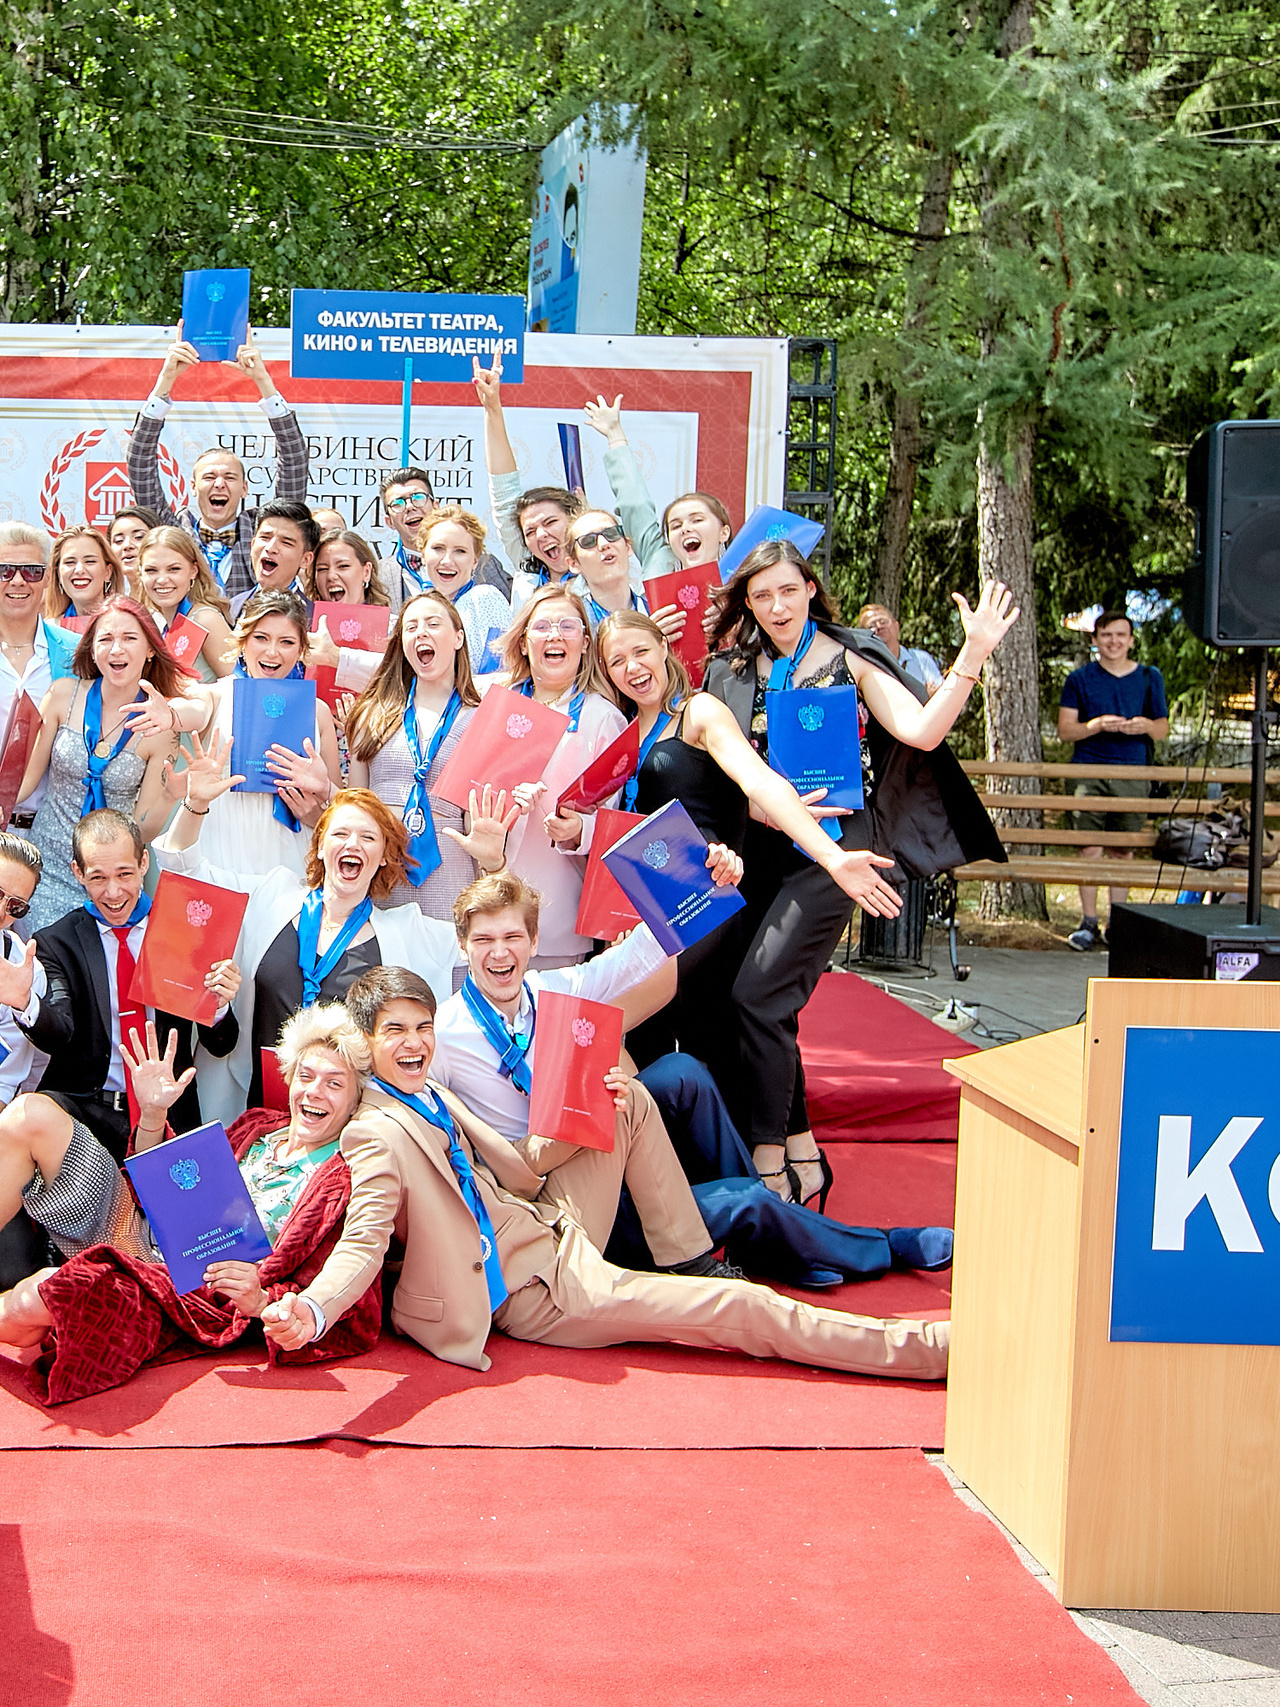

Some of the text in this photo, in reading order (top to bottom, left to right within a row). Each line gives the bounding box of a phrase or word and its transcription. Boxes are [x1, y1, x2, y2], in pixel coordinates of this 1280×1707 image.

[317, 310, 504, 333] ФАКУЛЬТЕТ ТЕАТРА,
[303, 334, 518, 356] КИНО и ТЕЛЕВИДЕНИЯ
[216, 434, 474, 463] ЧЕЛБИНСКИЙ
[1222, 956, 1251, 966] ALFA
